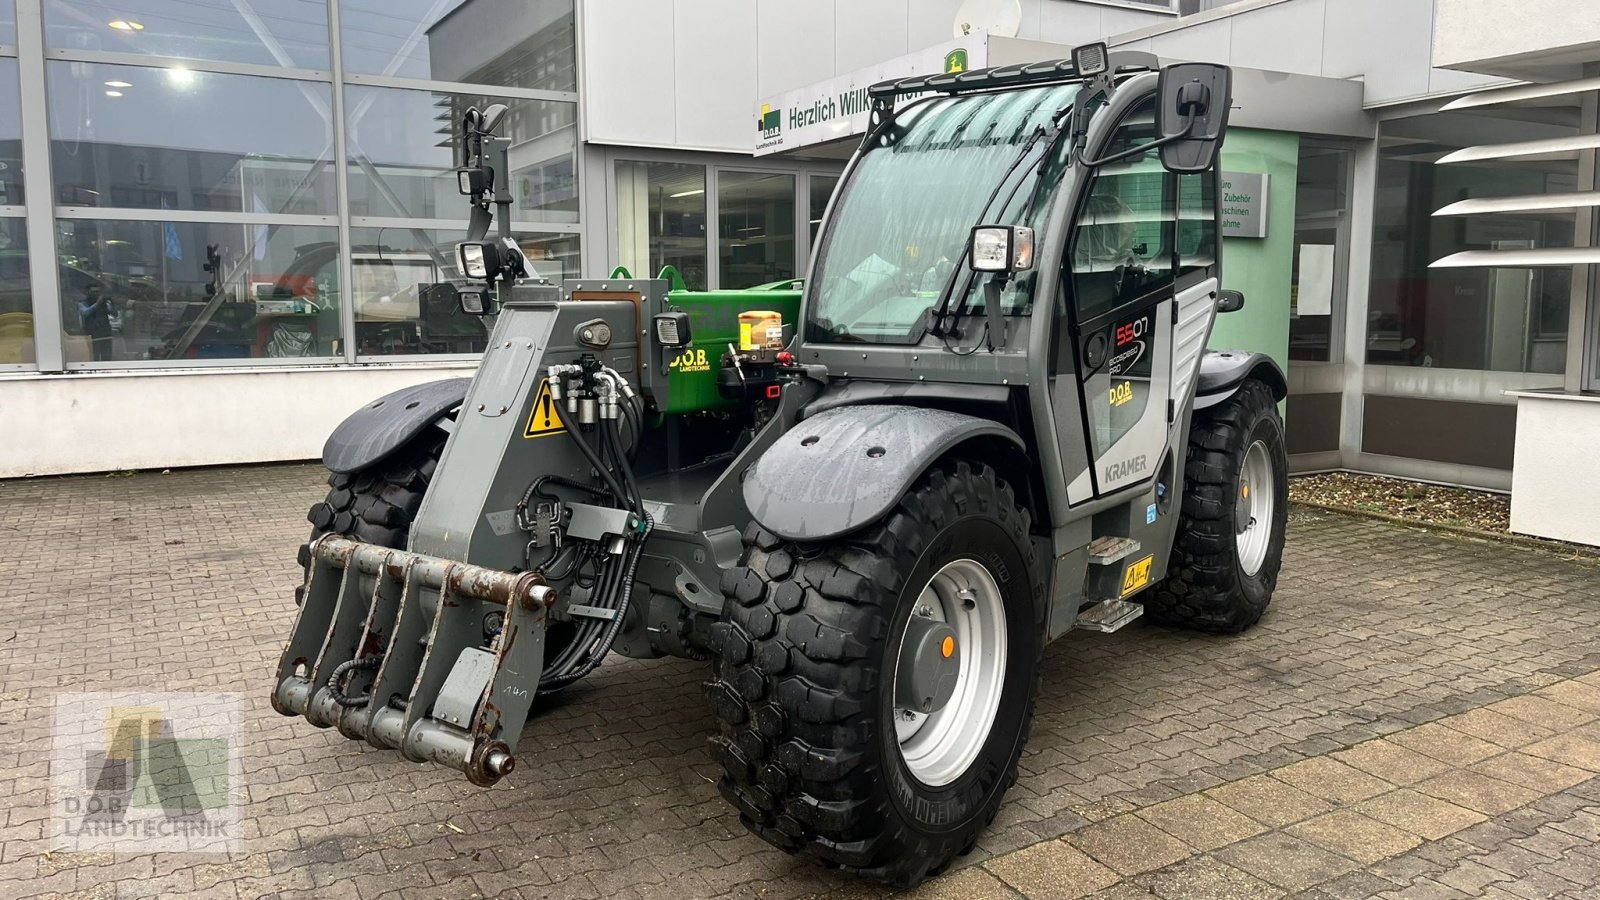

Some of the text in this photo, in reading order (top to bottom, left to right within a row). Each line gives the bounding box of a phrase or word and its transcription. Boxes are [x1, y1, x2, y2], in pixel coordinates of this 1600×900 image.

[790, 97, 836, 130] Herzlich
[1223, 193, 1251, 203] Zubehör
[1221, 206, 1250, 216] schinen
[1222, 219, 1241, 229] ahme
[1109, 364, 1122, 375] PRO
[1109, 380, 1133, 405] D.O.B.
[1104, 454, 1147, 484] KRAMER
